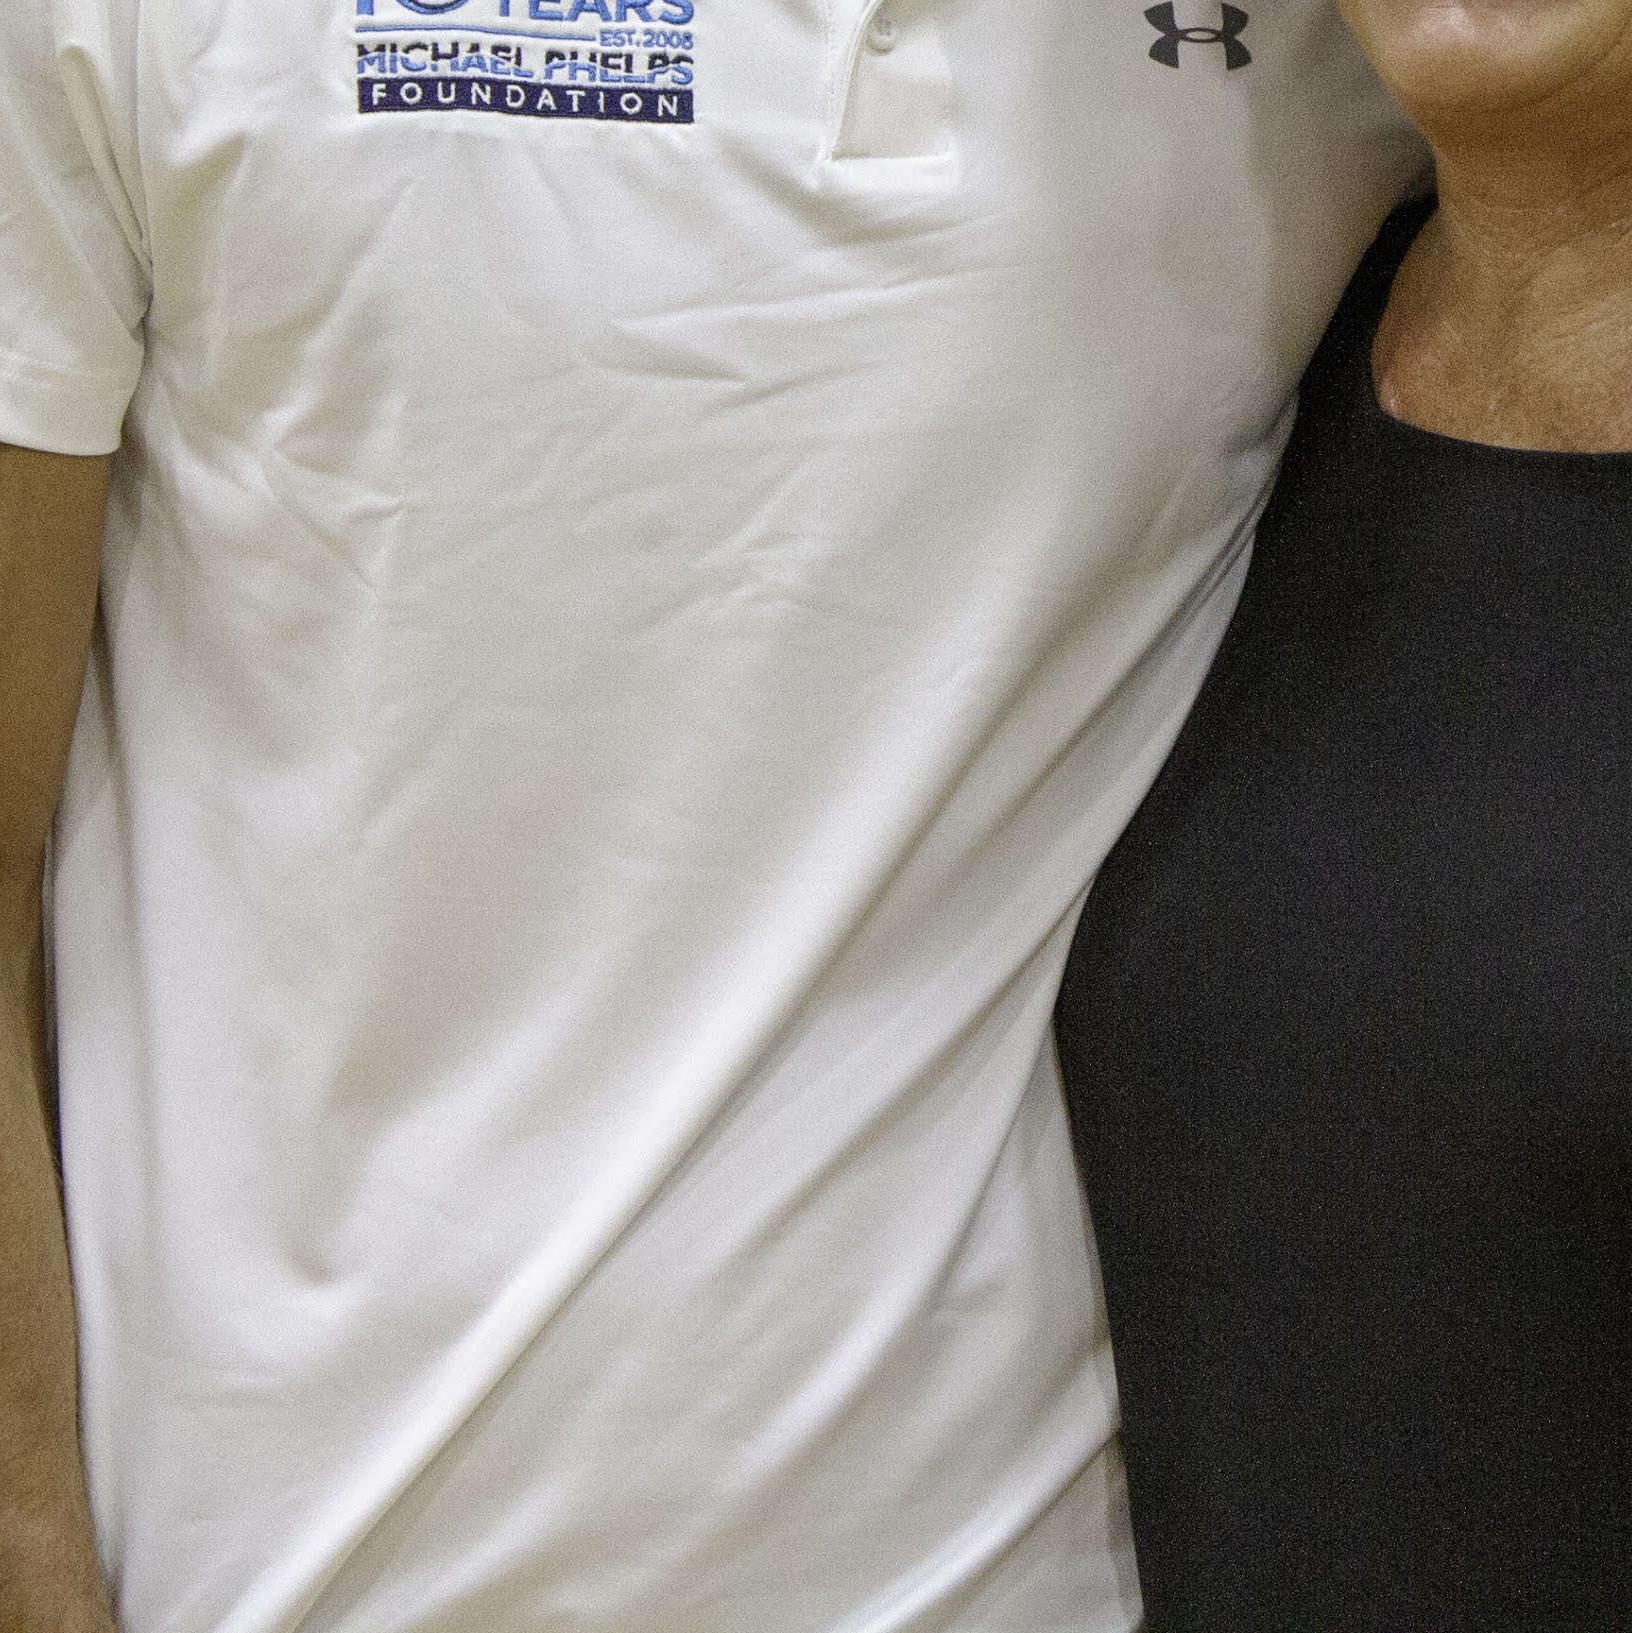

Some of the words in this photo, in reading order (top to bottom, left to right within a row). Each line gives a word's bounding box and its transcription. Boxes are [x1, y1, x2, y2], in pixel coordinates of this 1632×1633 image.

[356, 42, 536, 79] MICHAEL
[543, 50, 695, 86] PHELPS
[371, 82, 680, 118] FOUNDATION
